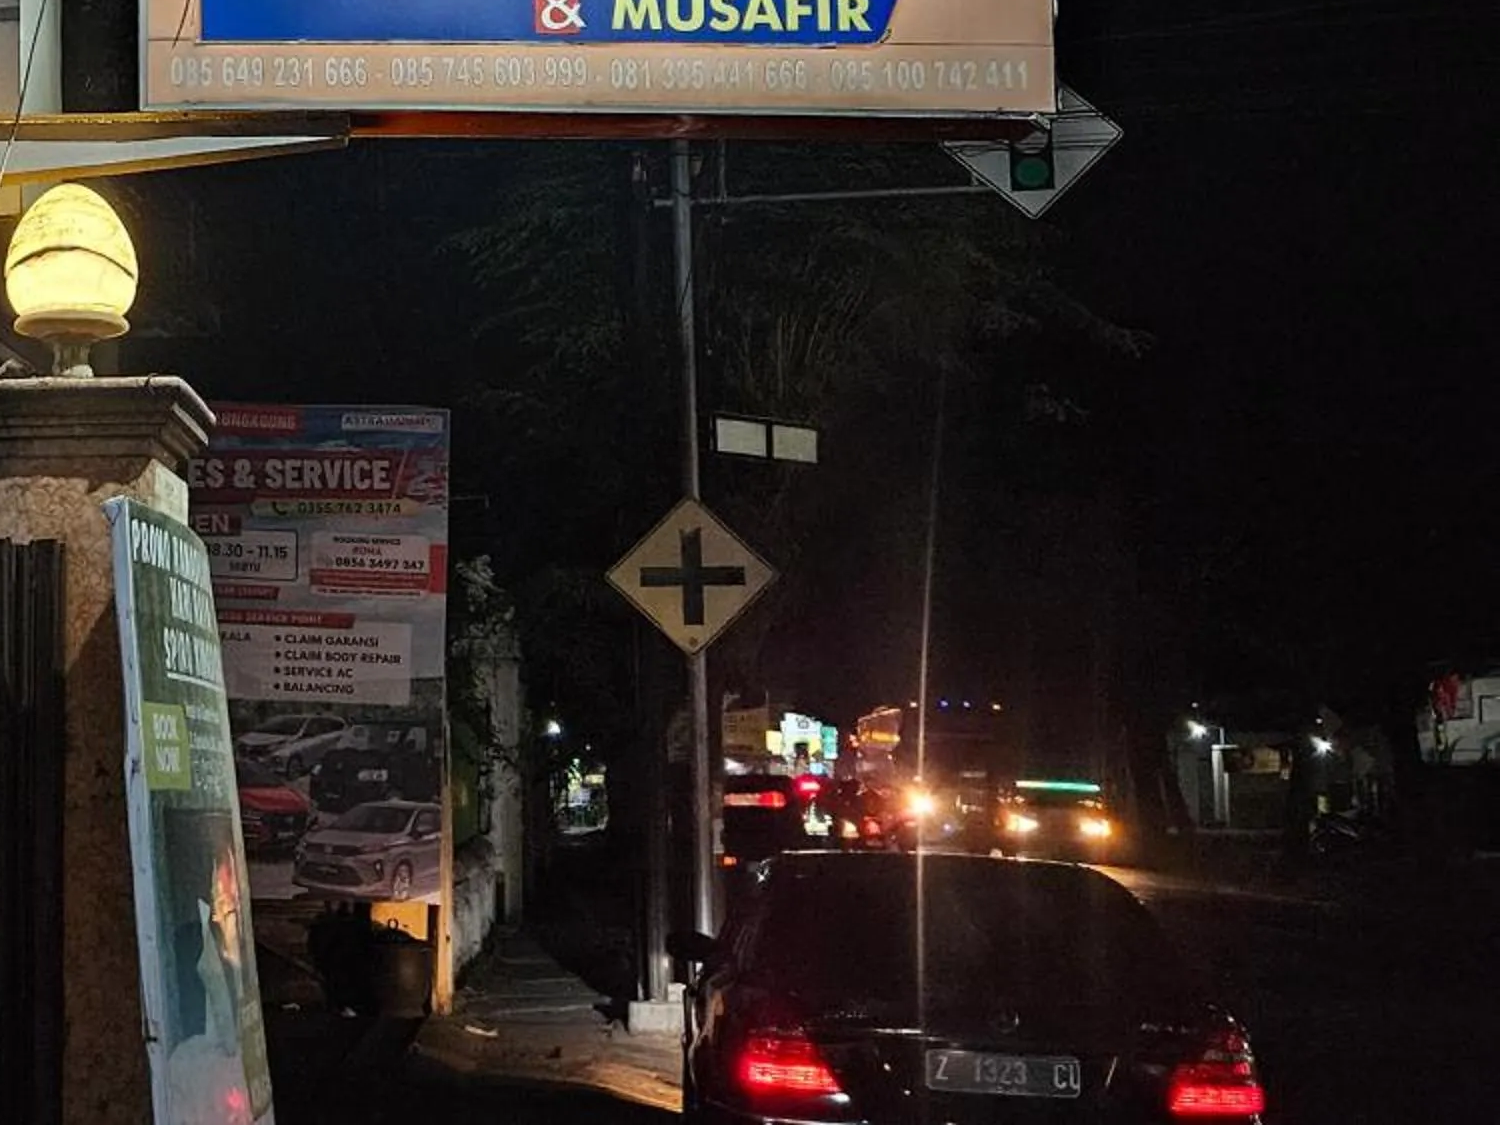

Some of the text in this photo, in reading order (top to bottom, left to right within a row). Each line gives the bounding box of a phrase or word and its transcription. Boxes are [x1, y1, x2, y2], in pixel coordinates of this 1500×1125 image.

[170, 57, 212, 87] 085
[324, 57, 369, 87] 666
[390, 57, 434, 87] 085
[265, 458, 392, 491] SERVICE
[283, 634, 380, 648] CLAIM GARANSI
[283, 650, 322, 661] CLAIM
[283, 666, 354, 678] SERVICE AC
[283, 682, 355, 695] BALANCING
[934, 1055, 949, 1081] Z
